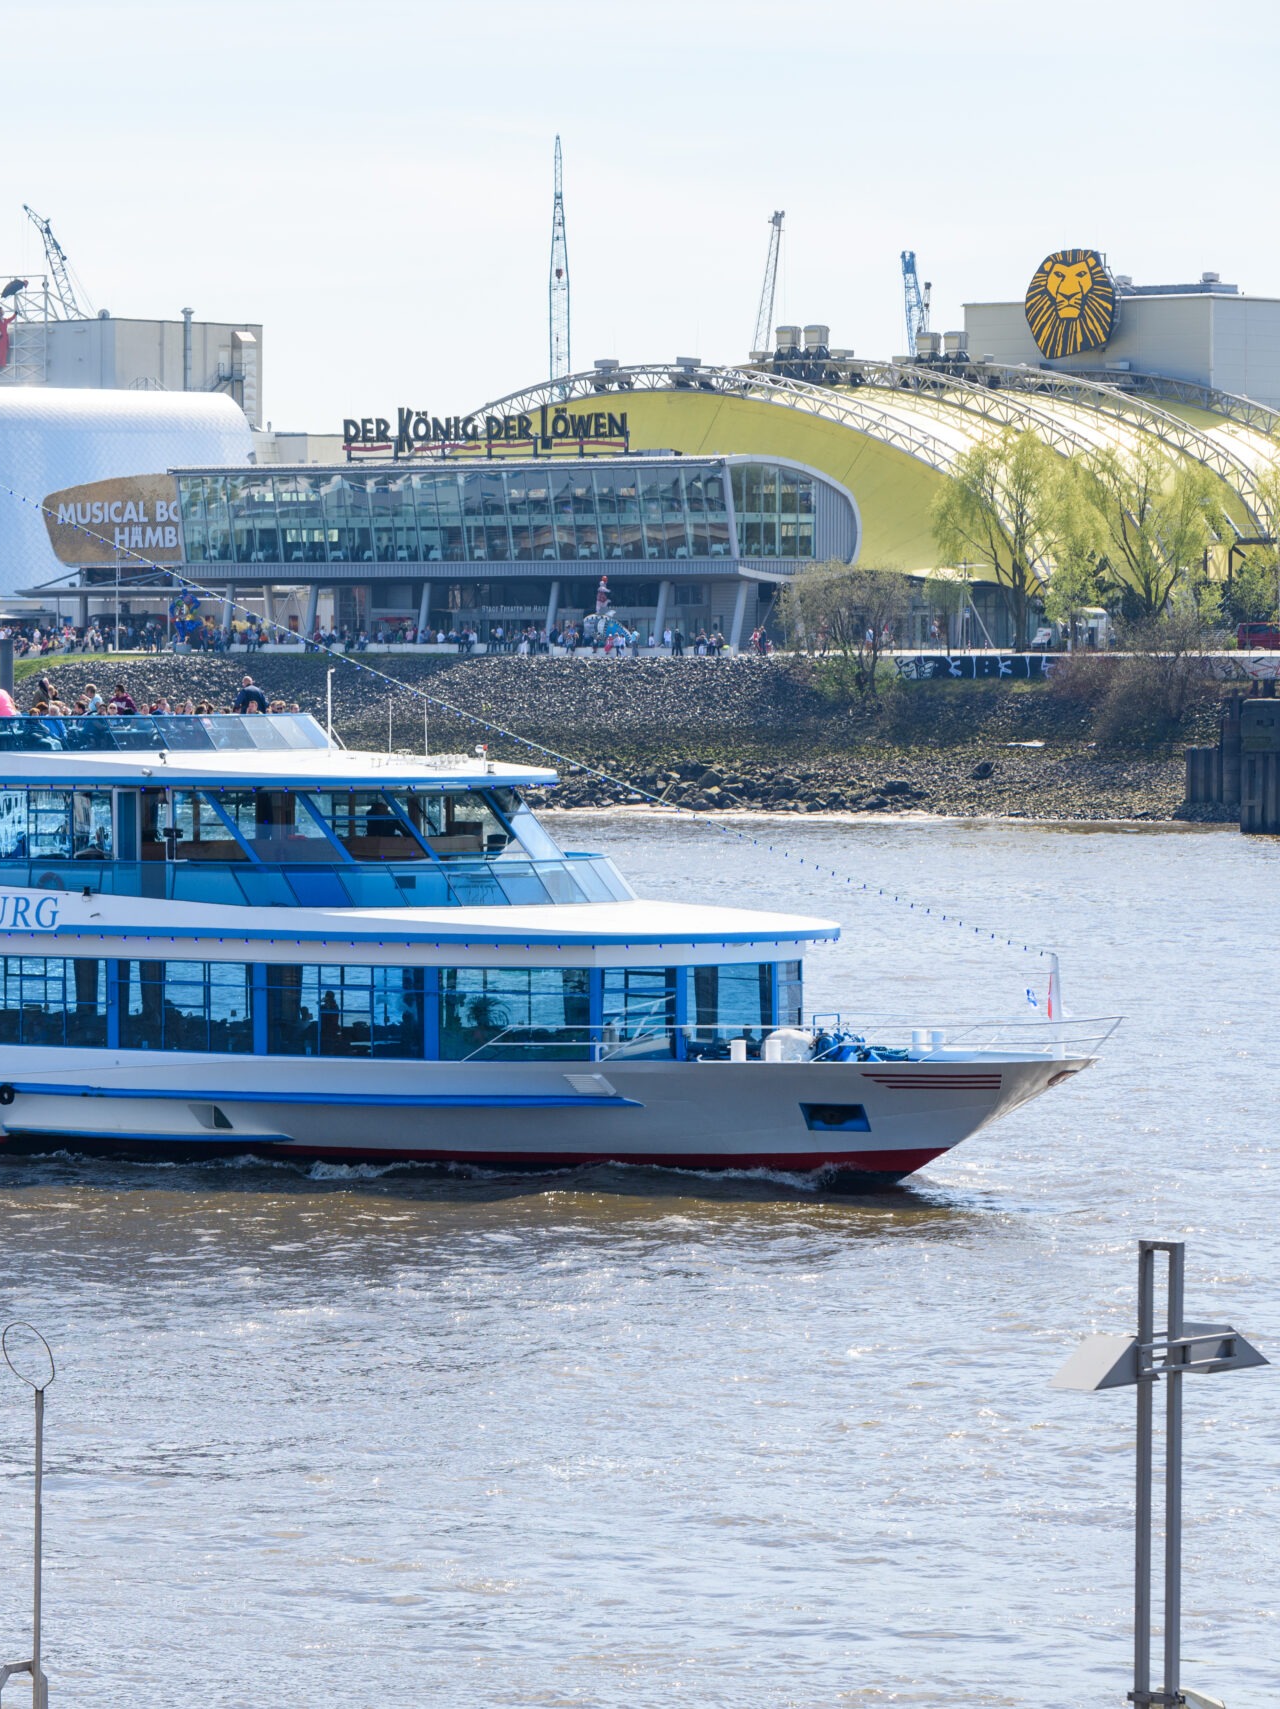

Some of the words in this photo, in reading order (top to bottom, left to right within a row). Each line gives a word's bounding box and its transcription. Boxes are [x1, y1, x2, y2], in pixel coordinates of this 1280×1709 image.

[342, 417, 391, 443] DER
[397, 407, 480, 452] KÖNIG
[485, 414, 533, 440] DER
[540, 404, 628, 450] LÖWEN
[56, 501, 149, 525] MUSICAL
